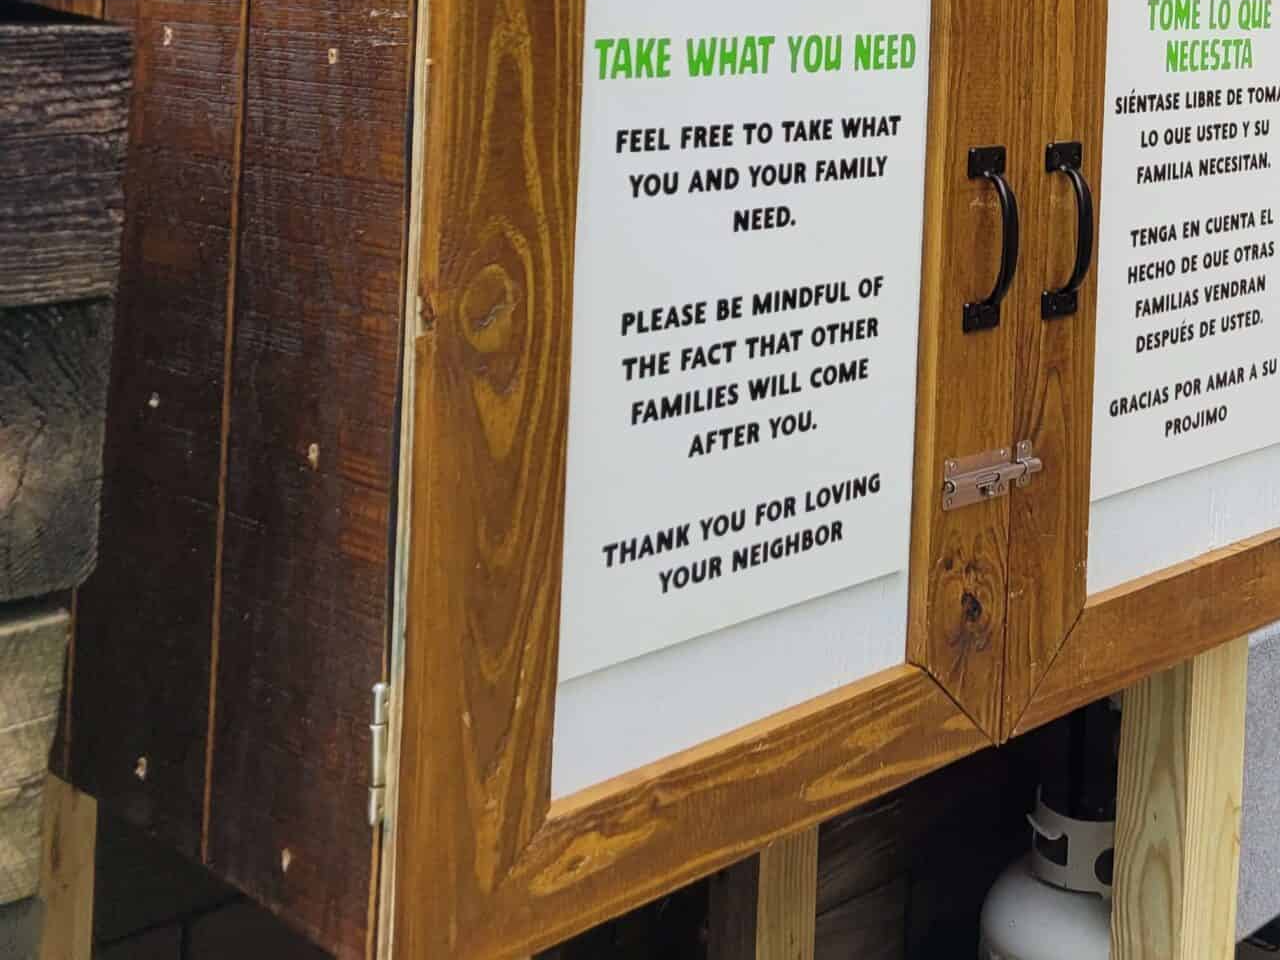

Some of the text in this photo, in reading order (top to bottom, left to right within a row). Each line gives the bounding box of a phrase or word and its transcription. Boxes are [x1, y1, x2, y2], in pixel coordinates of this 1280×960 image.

[595, 33, 916, 80] TAKE WHAT YOU NEED
[1166, 38, 1253, 72] NECESITA
[1115, 89, 1180, 115] SIÉNTASE
[1185, 89, 1222, 109] LIBRE
[1227, 88, 1242, 106] DE
[616, 116, 901, 153] FEEL FREE TO TAKE WHAT
[1140, 119, 1270, 148] LO QUE USTED Y SU
[630, 156, 888, 198] YOU AND YOUR FAMILY
[1136, 152, 1272, 185] FAMILIA NECESITAN.
[733, 206, 796, 233] NEED.
[1130, 208, 1274, 249] TENGA EN CUENTA EL
[1128, 241, 1275, 284] HECHO DE QUE OTRAS
[621, 276, 884, 336] PLEASE BE MINDFUL OF
[1135, 275, 1266, 319] FAMILIAS VENDRAN
[622, 317, 879, 381] THE FACT THAT OTHER
[1136, 309, 1264, 354] DESPUÉS DE USTED.
[630, 358, 869, 426] FAMILIES WILL COME
[1109, 358, 1278, 417] GRACIAS POR AMAR A SU
[688, 410, 818, 458] AFTER YOU.
[1165, 405, 1228, 438] PROJIMO
[602, 473, 882, 568] THANK YOU FOR LOVING
[658, 521, 843, 594] YOUR NEIGHBOR
